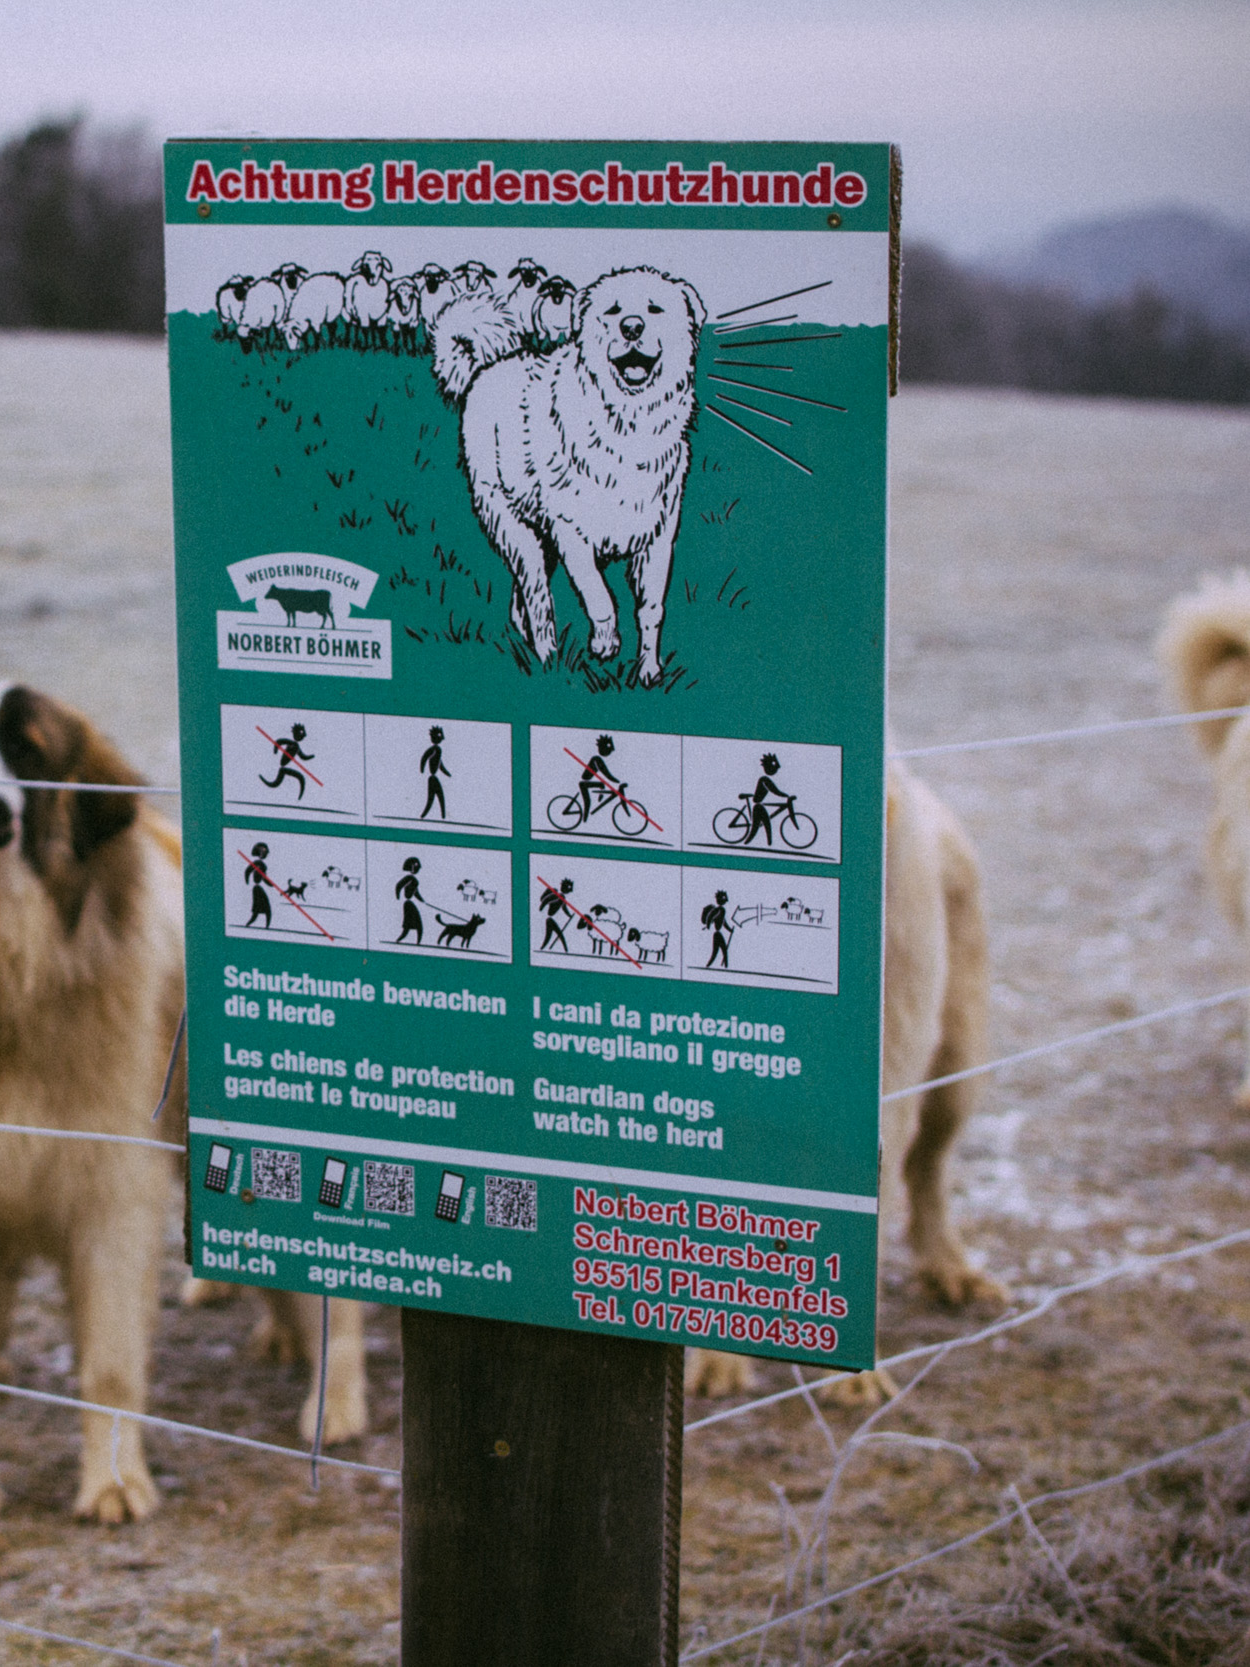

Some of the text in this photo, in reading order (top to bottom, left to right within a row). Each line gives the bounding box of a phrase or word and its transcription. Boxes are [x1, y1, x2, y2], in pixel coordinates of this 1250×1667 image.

[187, 160, 867, 211] Achtung Herdenschutzhunde
[246, 565, 360, 590] WEIDERINDFLEISCH
[228, 632, 381, 659] NORBERT BÖHMER
[224, 965, 506, 1015] Schutzhunde bewachen
[225, 995, 335, 1027] die Herde
[533, 996, 785, 1043] I cani da protezione
[224, 1043, 514, 1095] Les chiens de protection
[533, 1031, 801, 1078] sorvegliano il gregge
[225, 1076, 456, 1118] gardent le troupeau
[534, 1077, 714, 1121] Guardian dogs
[534, 1112, 723, 1150] watch the herd
[230, 1153, 244, 1195] Deutsch
[313, 1211, 390, 1230] Download Film
[462, 1186, 477, 1225] English
[574, 1187, 819, 1242] Norbert Böhmer
[203, 1222, 512, 1281] herdenschutzschweiz.ch
[203, 1247, 442, 1297] bul.ch agridea.ch
[574, 1222, 840, 1283] Schrenkersberg 1
[574, 1258, 848, 1317] 95515 Plankenfels
[573, 1293, 837, 1352] Tel. 0175/1804339
